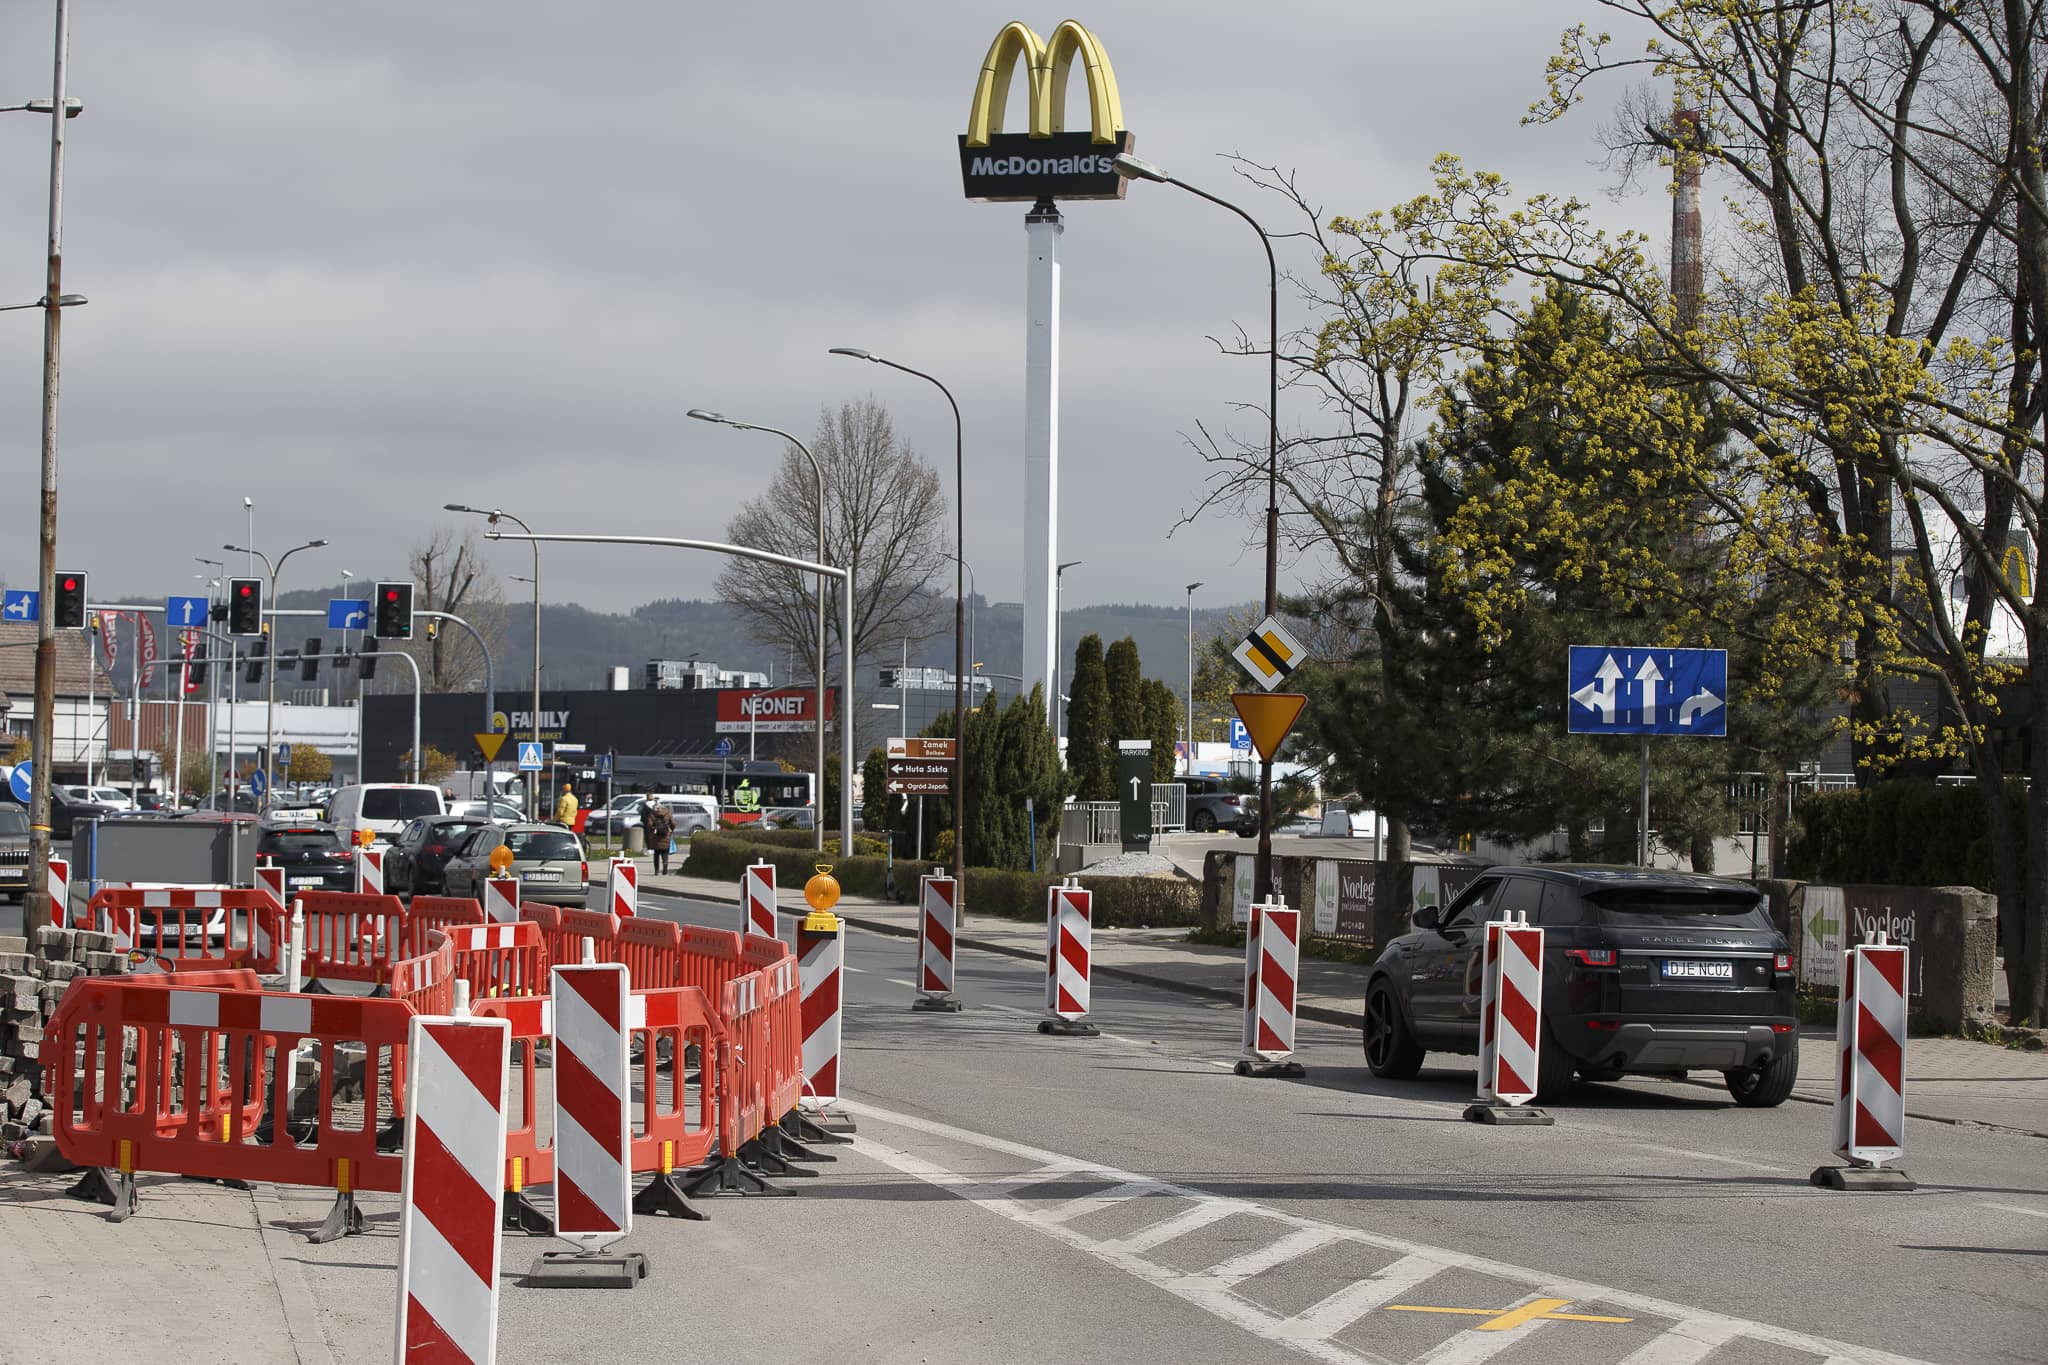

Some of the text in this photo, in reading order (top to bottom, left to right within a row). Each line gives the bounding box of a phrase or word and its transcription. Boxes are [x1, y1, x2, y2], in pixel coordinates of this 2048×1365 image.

[970, 155, 1114, 176] McDonald's
[740, 697, 805, 715] NEONET
[922, 740, 948, 749] Zamek
[1121, 749, 1149, 757] PARKING
[905, 765, 924, 773] Huta
[907, 783, 927, 791] Ogród
[1853, 907, 1917, 946] Noclegi
[1642, 935, 1753, 946] RANGE ROVER
[1670, 961, 1695, 976] DJE
